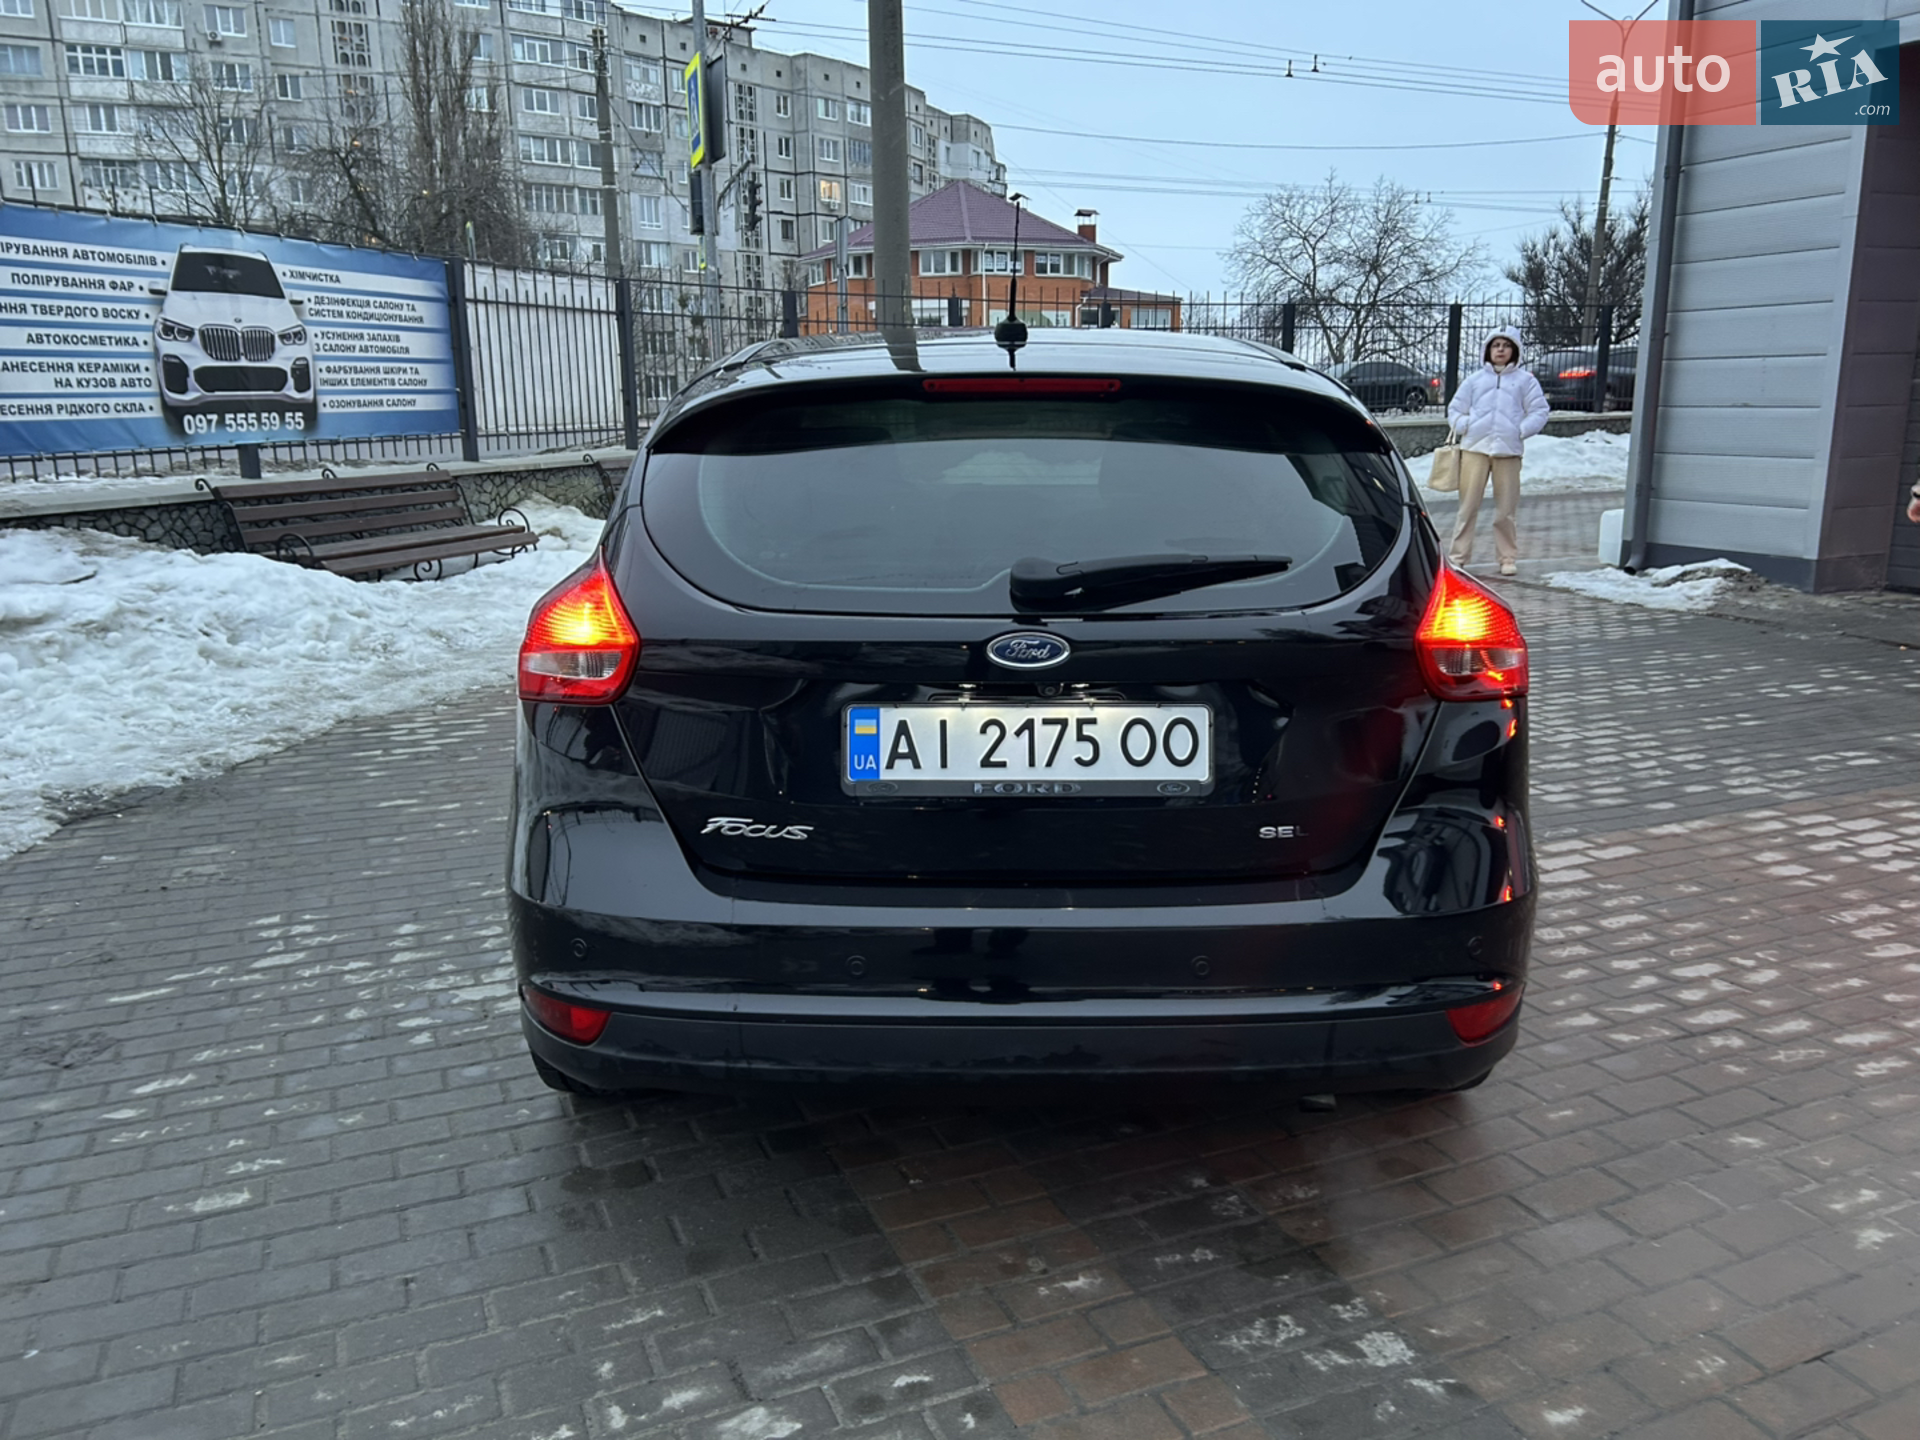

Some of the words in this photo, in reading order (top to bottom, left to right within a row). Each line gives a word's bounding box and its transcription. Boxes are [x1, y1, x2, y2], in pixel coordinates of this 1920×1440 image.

[72, 248, 157, 266] АВТОМОБІЛІВ
[11, 272, 106, 290] ПОЛІРУВАННЯ
[109, 280, 135, 292] ФАР
[288, 269, 341, 284] ХІМЧИСТКА
[314, 295, 371, 309] ДЕЗІНФЕКЦІЯ
[373, 300, 404, 312] САЛОНУ
[406, 303, 417, 312] ТА
[30, 304, 98, 318] ТВЕРДОГО
[102, 307, 141, 319] ВОСКУ
[308, 307, 344, 319] СИСТЕМ
[346, 312, 424, 324] КОНДИЦІОНУВАННЯ
[26, 333, 140, 347] АВТОКОСМЕТИКА
[320, 331, 366, 342] УСУНЕННЯ
[366, 333, 401, 343] ЗАПАХІВ
[322, 343, 356, 353] САЛОНУ
[358, 345, 410, 354] АВТОМОБІЛЯ
[1, 361, 74, 374] АНЕСЕННЯ
[77, 362, 141, 374] КЕРАМІКИ
[325, 365, 381, 375] ФАРБУВАННЯ
[410, 367, 420, 375] ТА
[54, 377, 73, 388] НА
[76, 377, 117, 388] КУЗОВ
[120, 377, 152, 388] АВТО
[350, 378, 396, 387] ЕЛЕМЕНТІВ
[397, 378, 427, 387] САЛОНУ
[56, 402, 110, 416] РІДКОГО
[113, 402, 146, 414] СКЛА
[329, 399, 384, 408] ОЗОНУВАННЯ
[386, 398, 416, 407] САЛОНУ
[183, 413, 218, 435] 097
[224, 412, 258, 433] 555
[260, 411, 280, 431] 59
[284, 411, 305, 430] 55
[1004, 640, 1052, 659] Ford
[884, 719, 948, 769] AI
[978, 717, 1100, 769] 2175
[1119, 716, 1200, 768] OO
[853, 755, 877, 770] UA
[973, 783, 1081, 795] FORD
